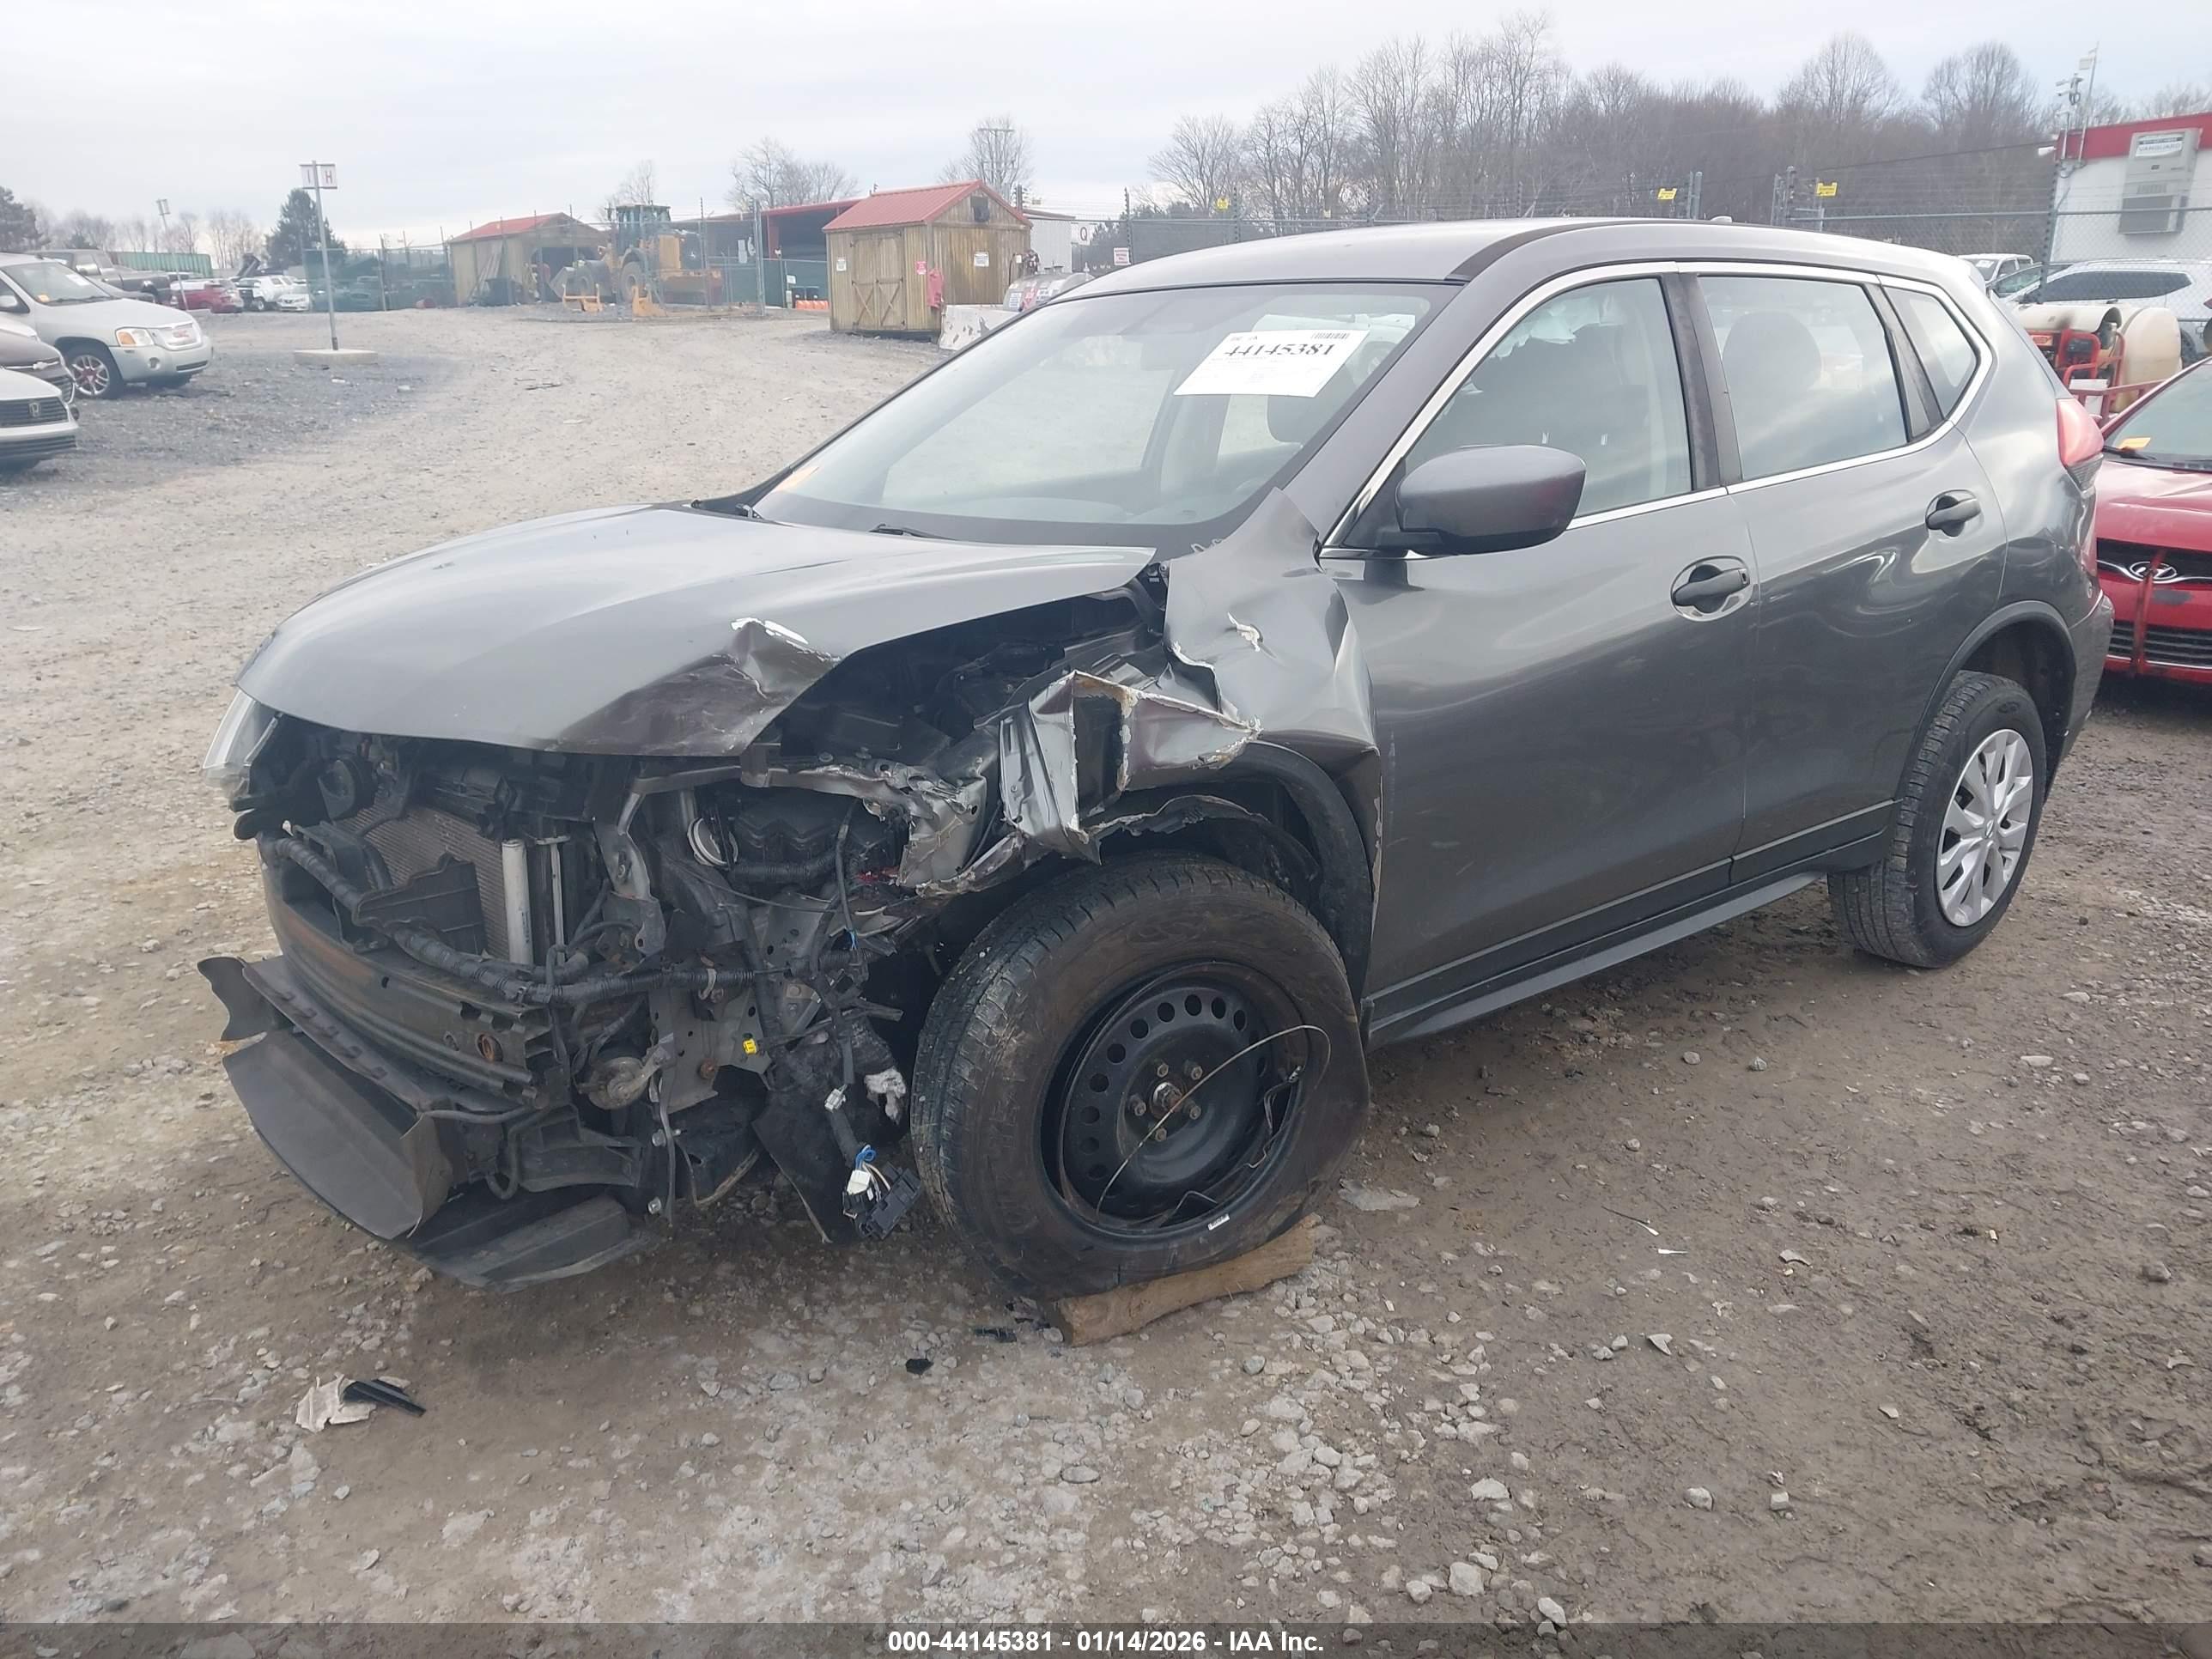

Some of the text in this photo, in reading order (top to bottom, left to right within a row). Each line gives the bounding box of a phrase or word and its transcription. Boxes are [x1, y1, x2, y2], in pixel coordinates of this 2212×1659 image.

[325, 169, 333, 185] H
[1079, 226, 1088, 241] Q
[1224, 343, 1336, 356] 44145381
